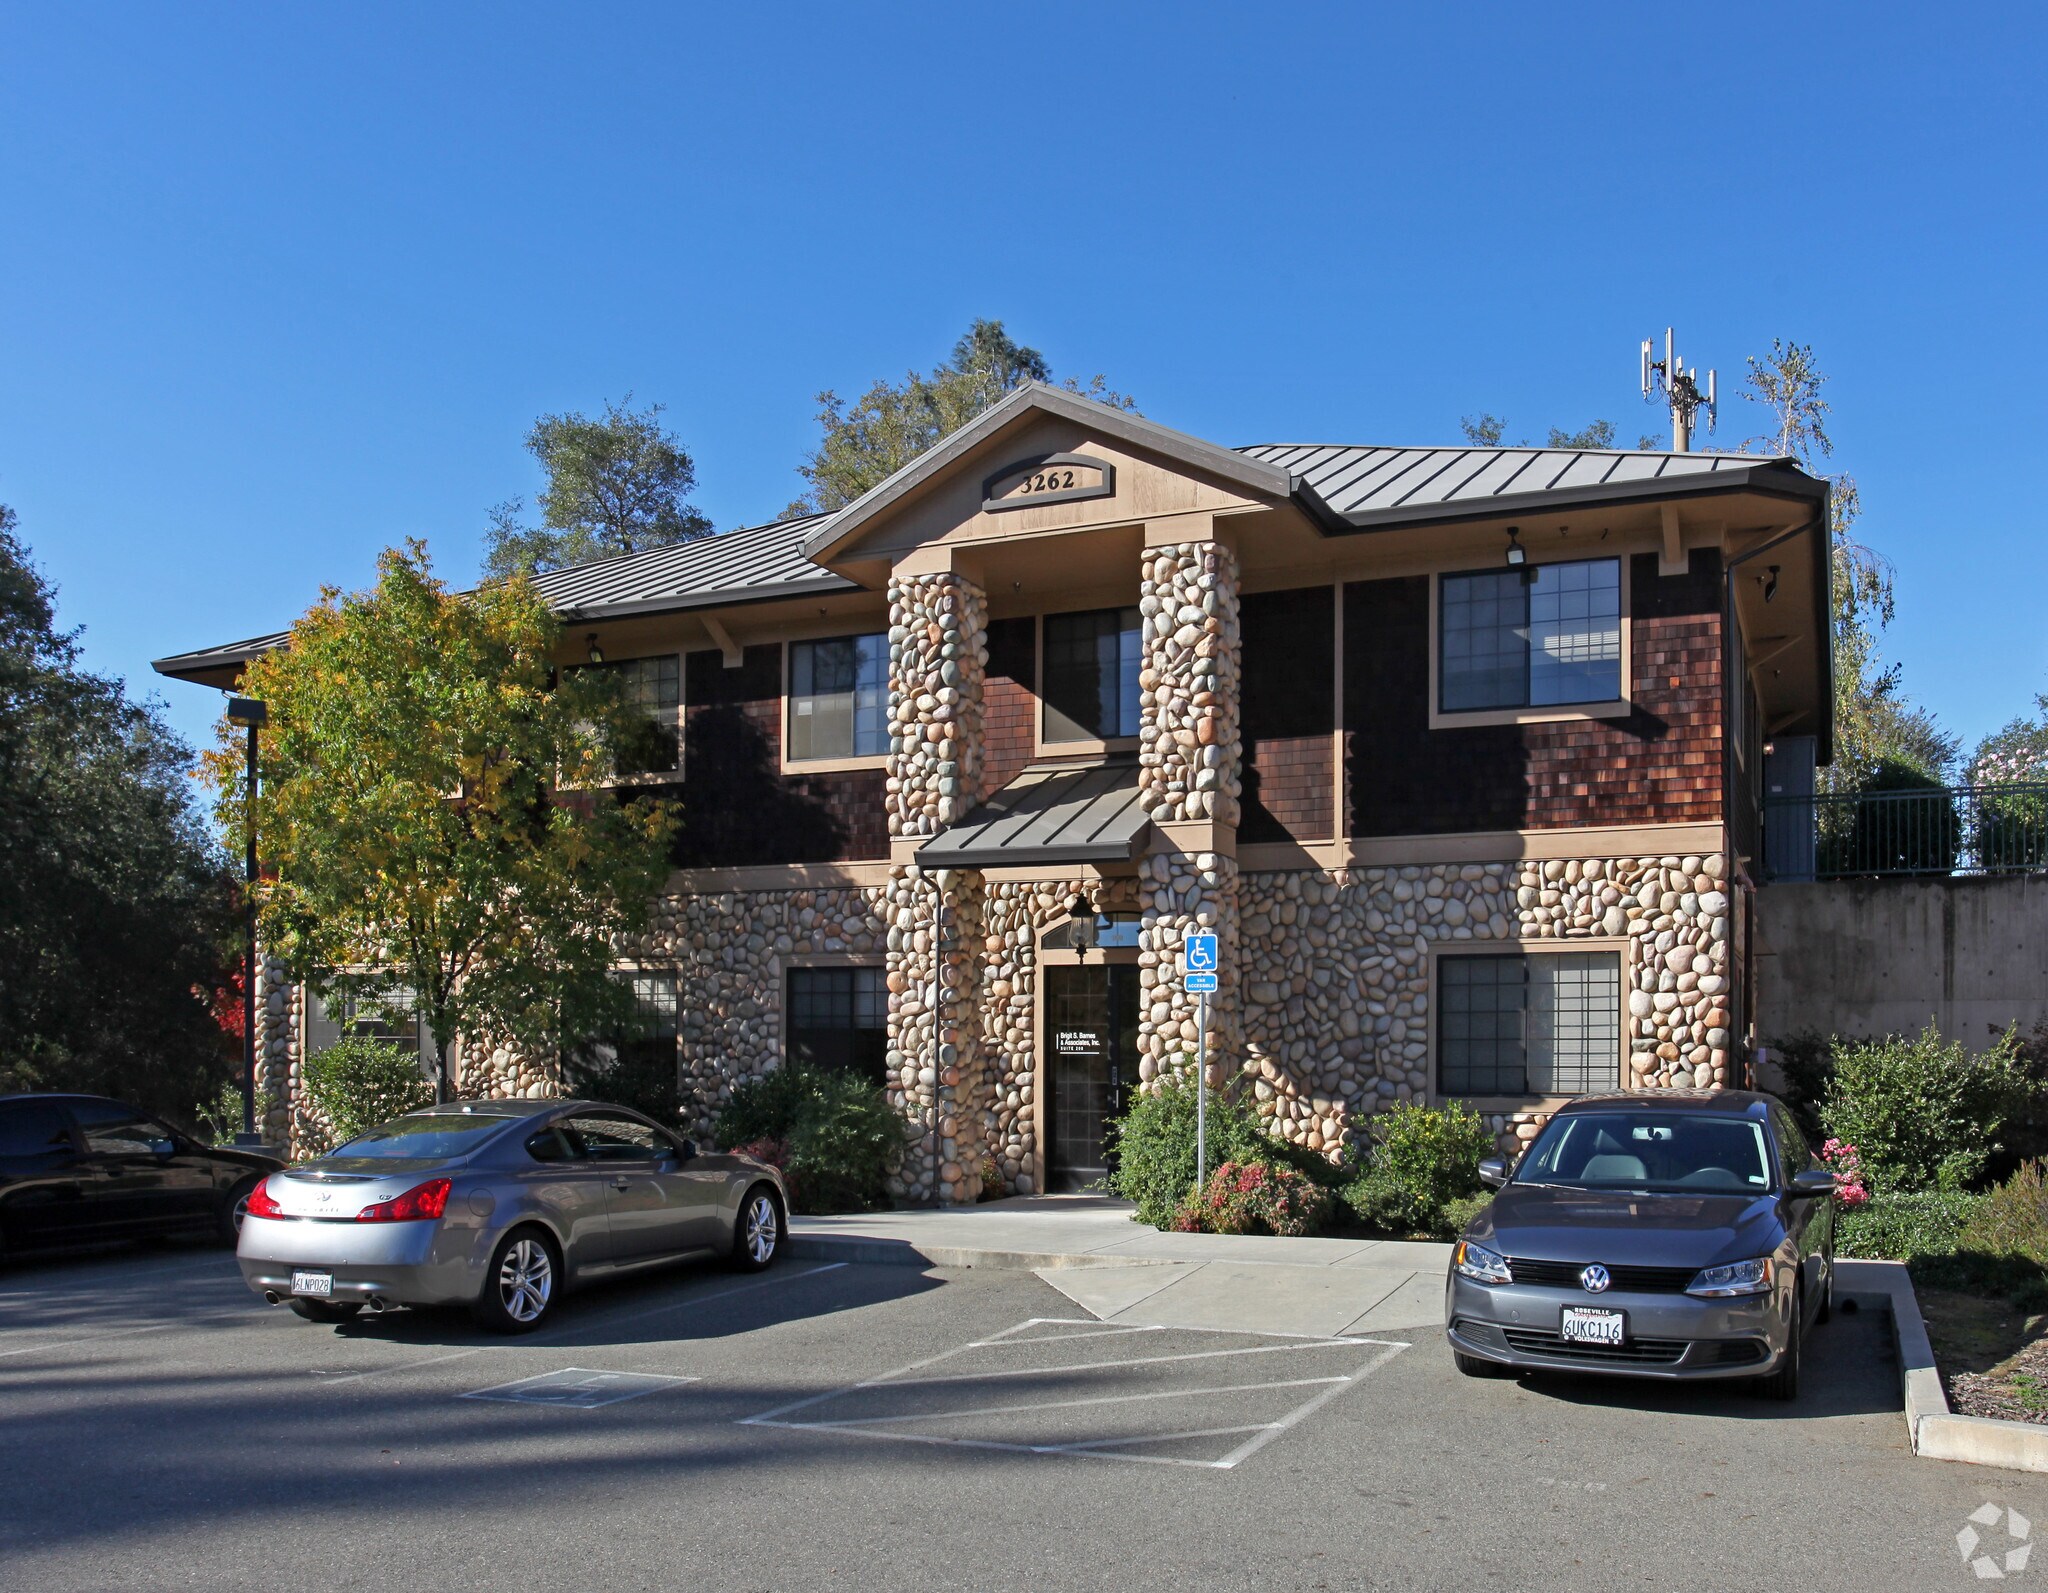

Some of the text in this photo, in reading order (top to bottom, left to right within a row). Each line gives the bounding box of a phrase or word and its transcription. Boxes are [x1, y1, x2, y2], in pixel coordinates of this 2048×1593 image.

[1020, 471, 1075, 494] 3262
[295, 1278, 329, 1292] 6LNP028
[1574, 1308, 1610, 1316] ROSEVILLE
[1564, 1320, 1620, 1338] 6UKC116
